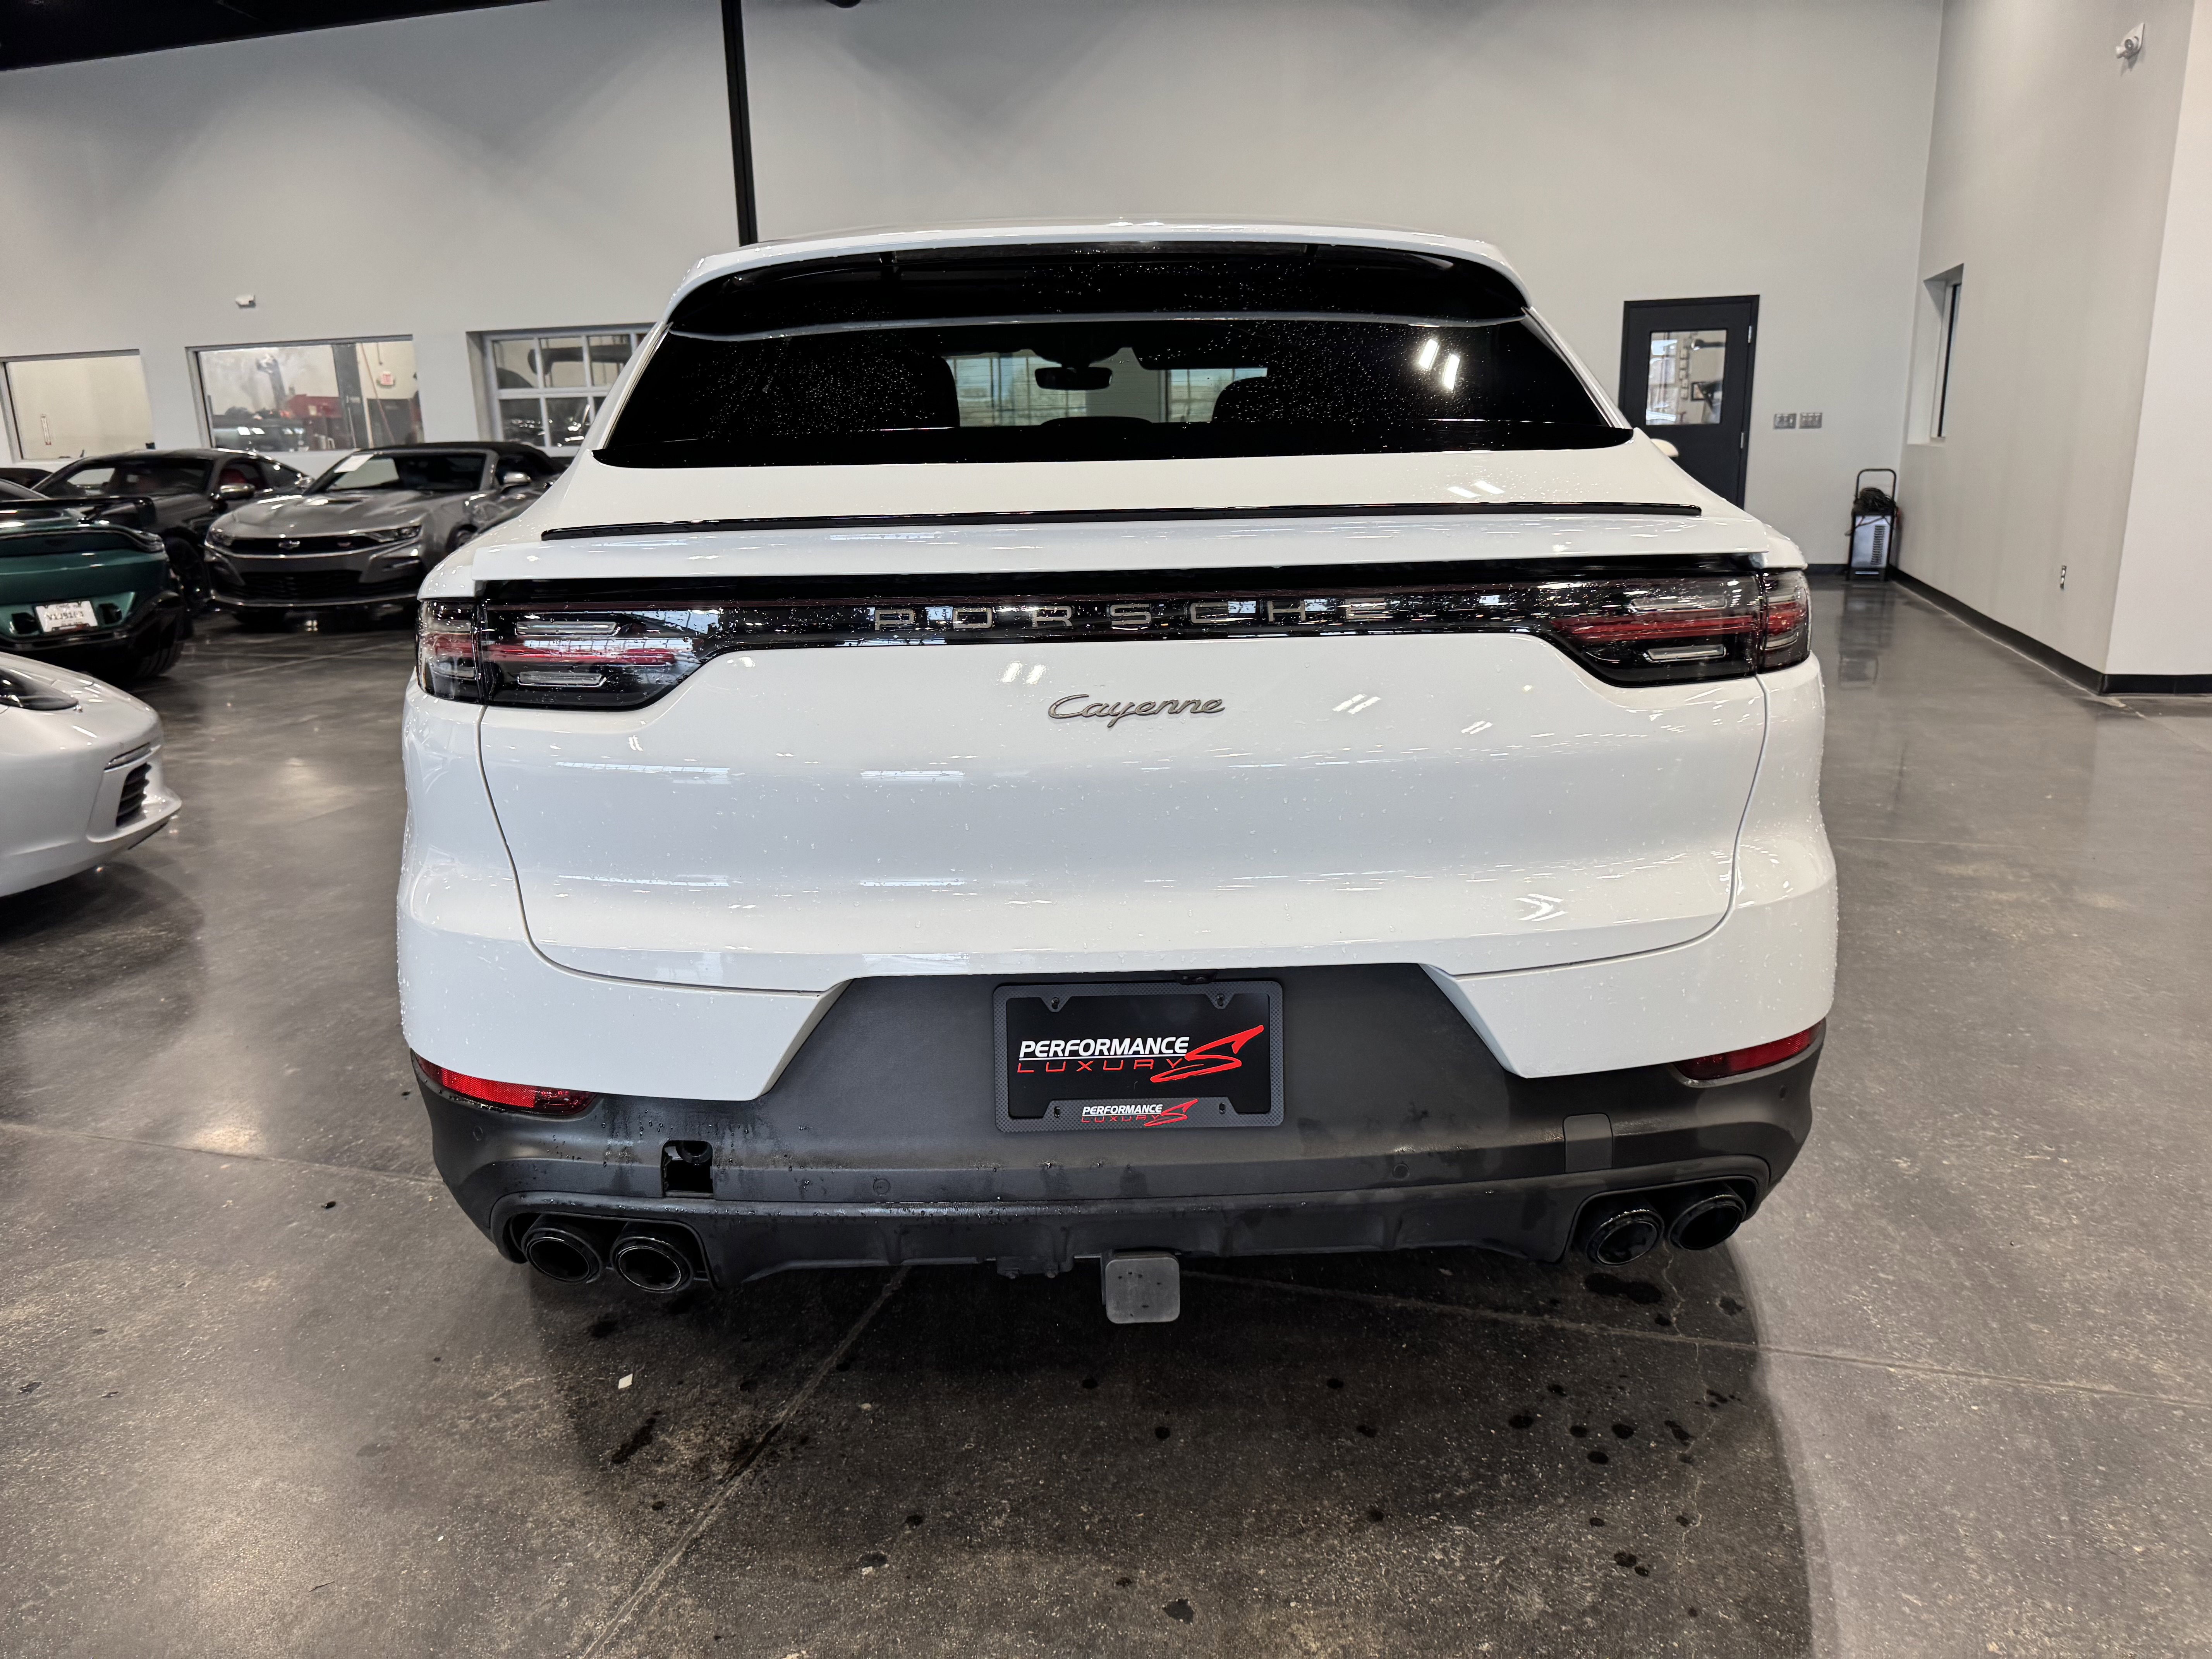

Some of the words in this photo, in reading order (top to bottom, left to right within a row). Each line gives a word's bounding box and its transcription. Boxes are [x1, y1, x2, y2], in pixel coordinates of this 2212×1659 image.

[874, 598, 1385, 631] PORSCHE
[1048, 694, 1225, 728] Cayenne
[1019, 1037, 1190, 1058] PERFORMANCE
[1017, 1058, 1183, 1073] LUXURY
[1081, 1114, 1160, 1123] LUXURY
[1082, 1104, 1163, 1115] PERFORMANCE
